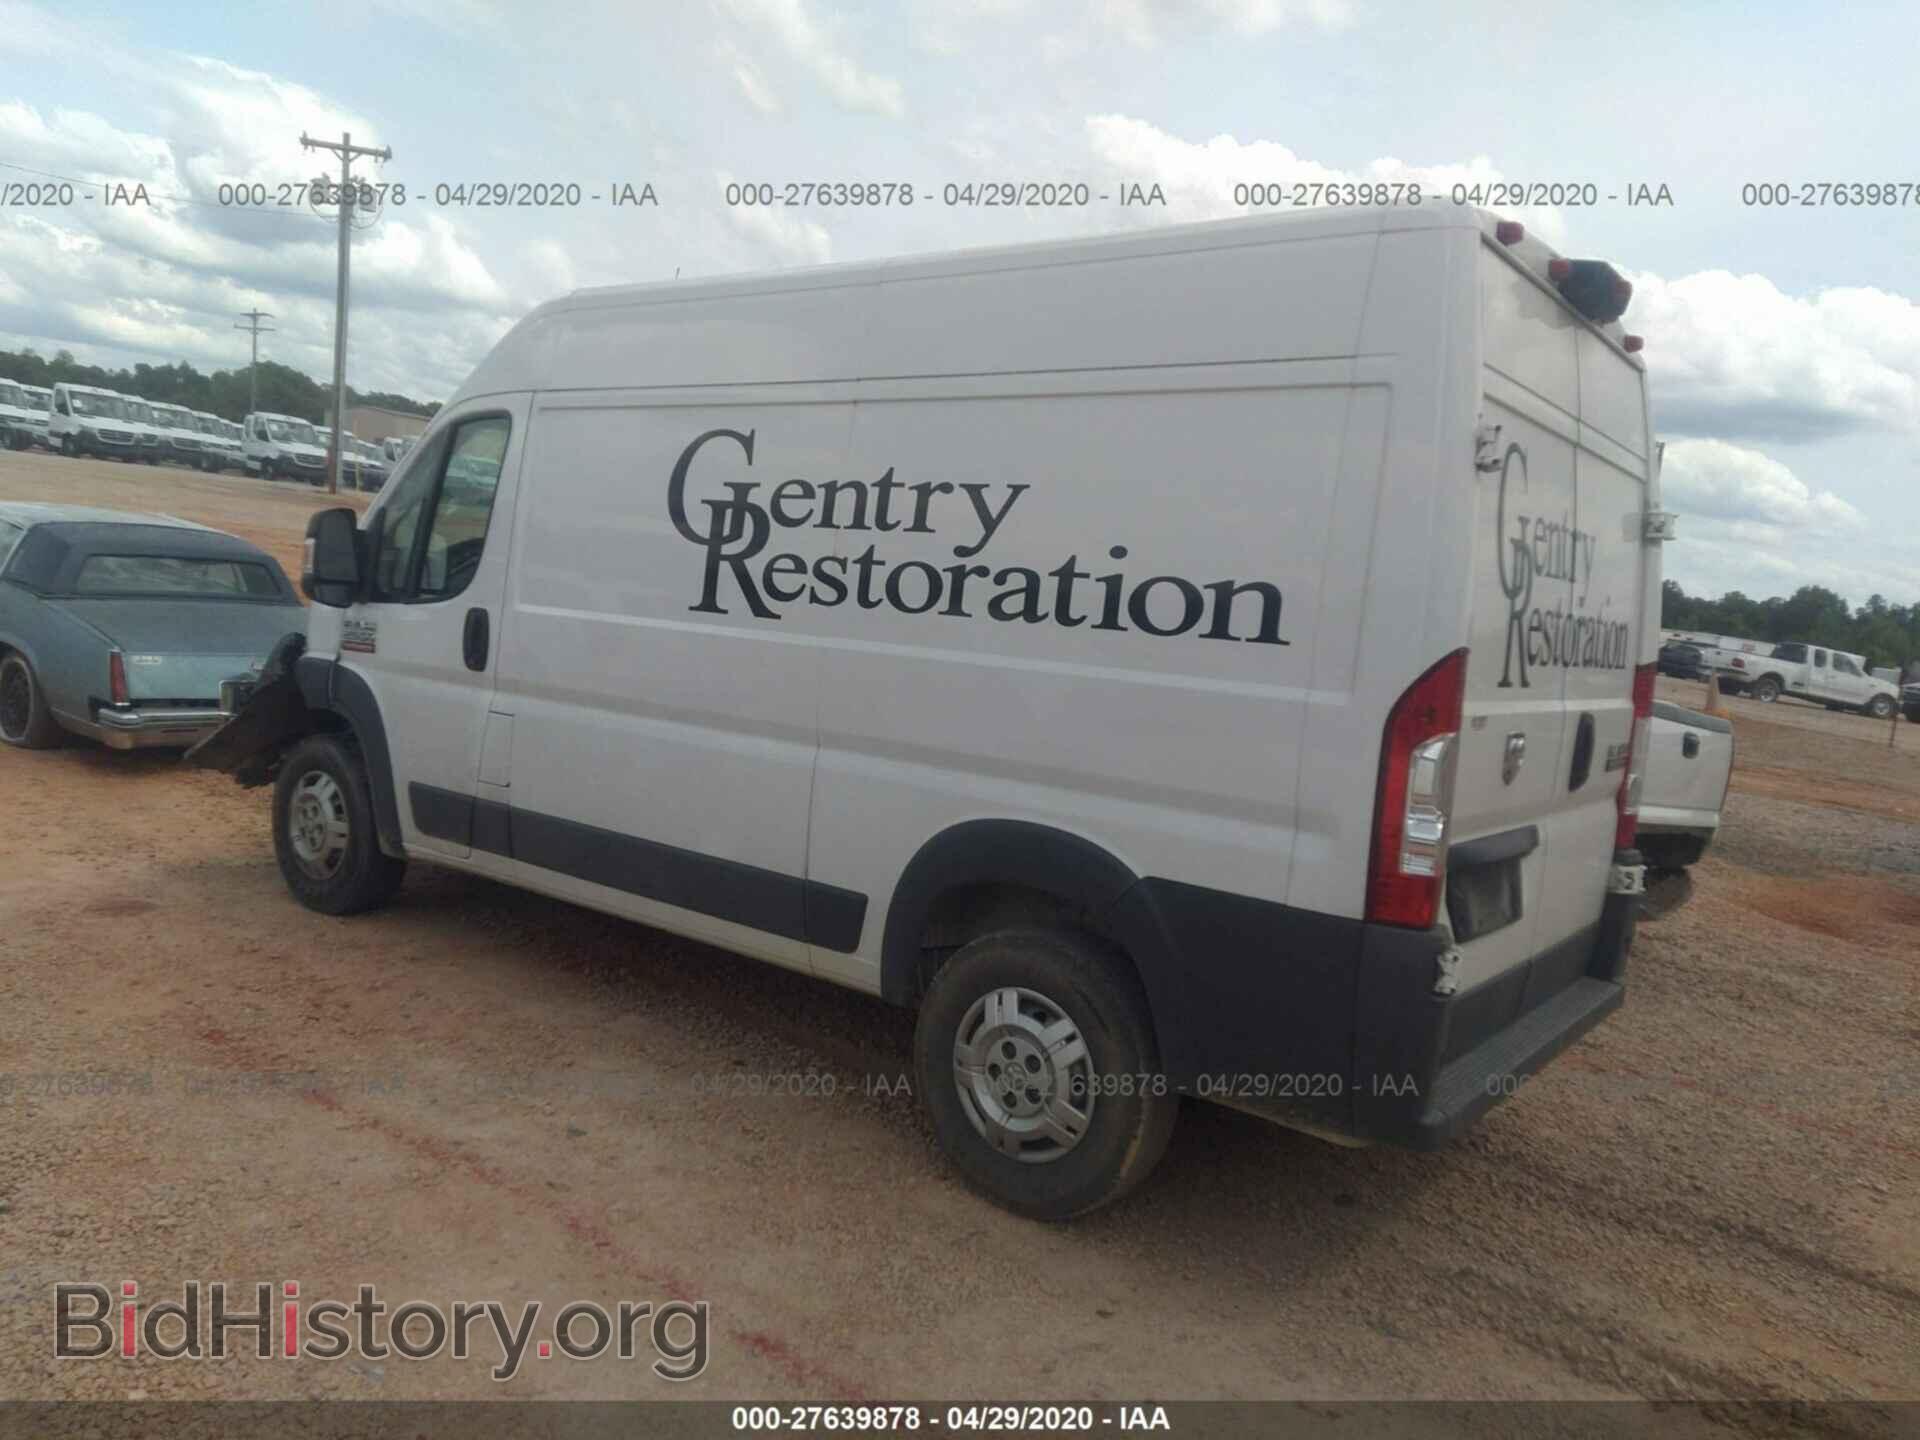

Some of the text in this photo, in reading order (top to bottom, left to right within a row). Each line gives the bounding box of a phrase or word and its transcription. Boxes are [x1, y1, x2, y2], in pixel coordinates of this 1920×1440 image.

[668, 428, 1031, 558] Gentry
[1497, 442, 1596, 606] Gentry
[688, 499, 1291, 647] Restoration
[1497, 540, 1629, 688] Restoration
